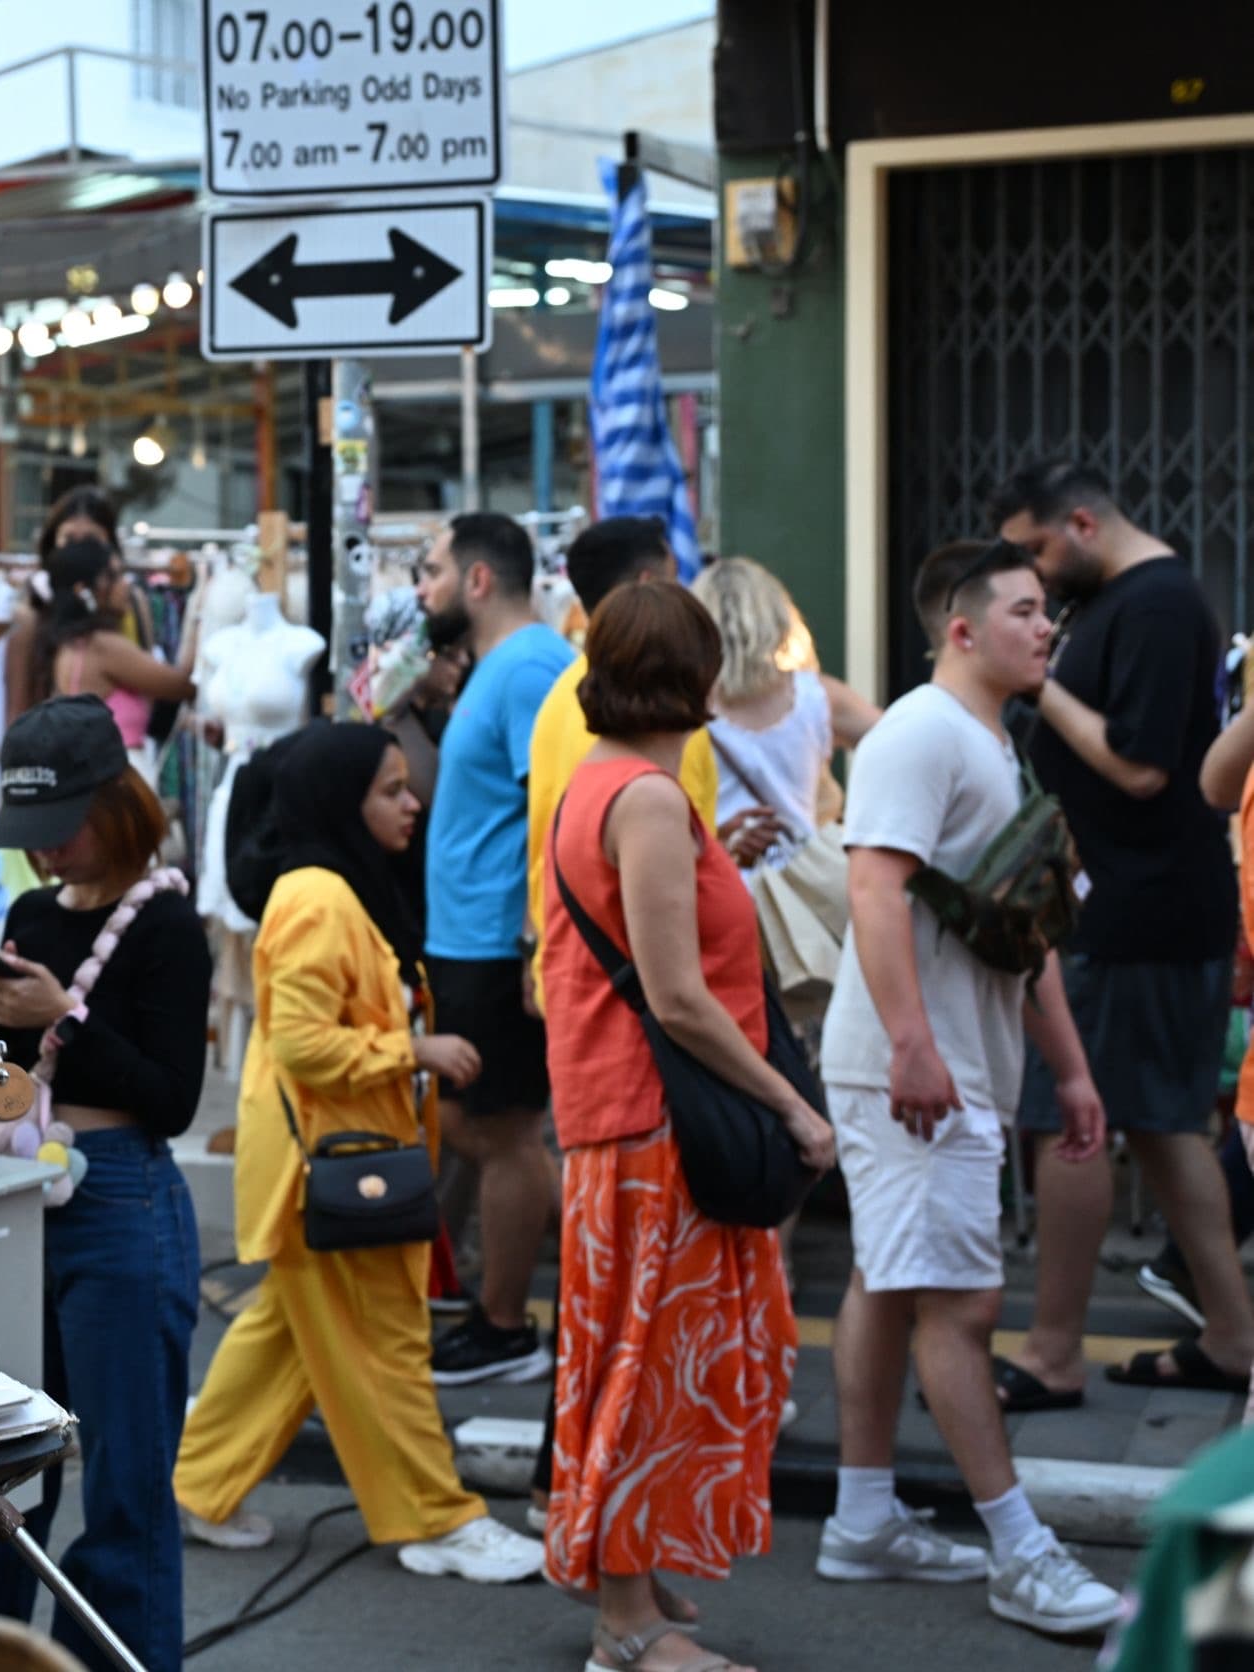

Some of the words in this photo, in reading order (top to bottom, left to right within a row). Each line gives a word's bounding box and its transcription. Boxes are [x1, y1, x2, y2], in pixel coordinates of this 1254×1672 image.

[217, 85, 250, 111] No
[261, 80, 351, 113] Parking
[362, 73, 412, 104] Odd
[423, 72, 482, 105] Days
[220, 130, 282, 171] 7.00
[442, 136, 487, 164] pm
